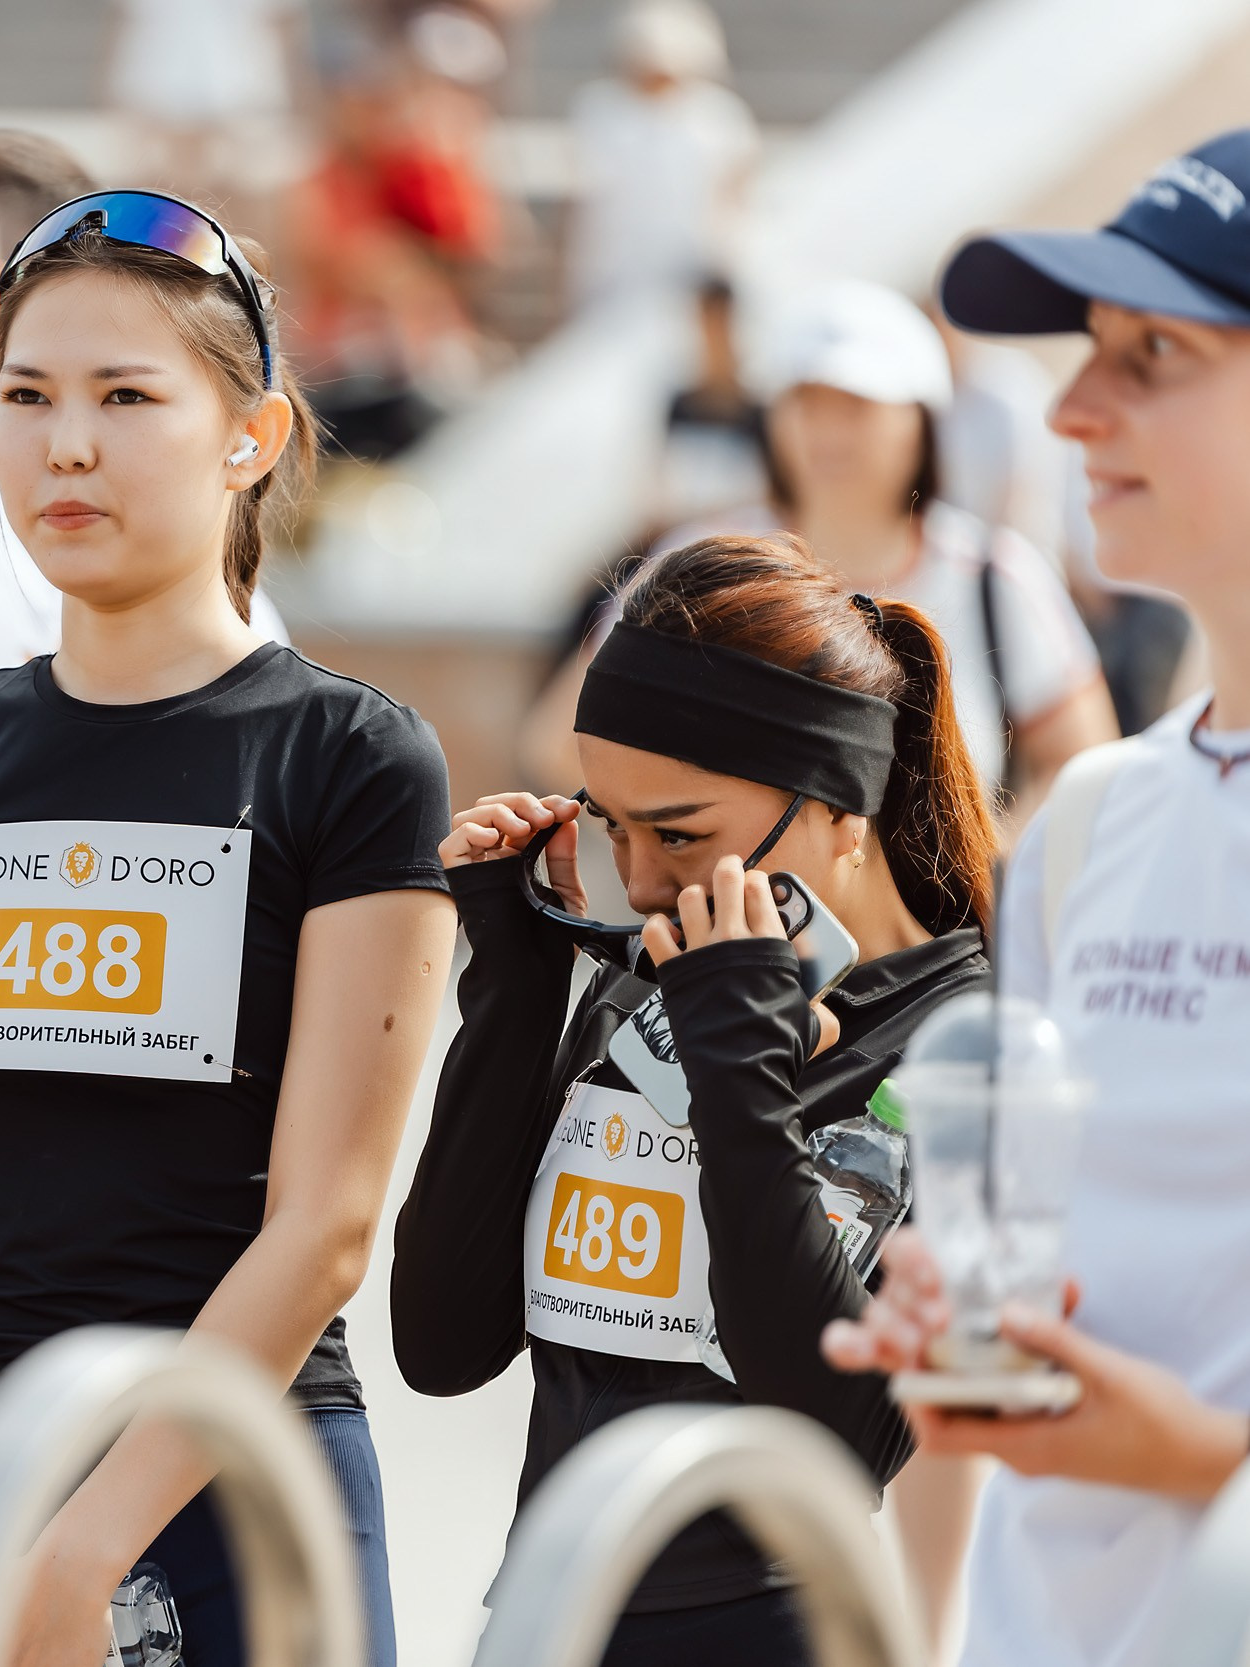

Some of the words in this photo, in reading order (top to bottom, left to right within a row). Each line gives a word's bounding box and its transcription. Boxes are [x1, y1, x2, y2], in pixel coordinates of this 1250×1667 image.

[110, 855, 215, 887] D'ORO
[141, 1032, 200, 1051] ЗАБЕГ
[636, 1130, 702, 1166] D'OR
[553, 1189, 662, 1280] 489
[530, 1289, 654, 1330] БЛАГОТВОРИТЕЛЬНЫЙ
[659, 1315, 699, 1334] ЗАБ
